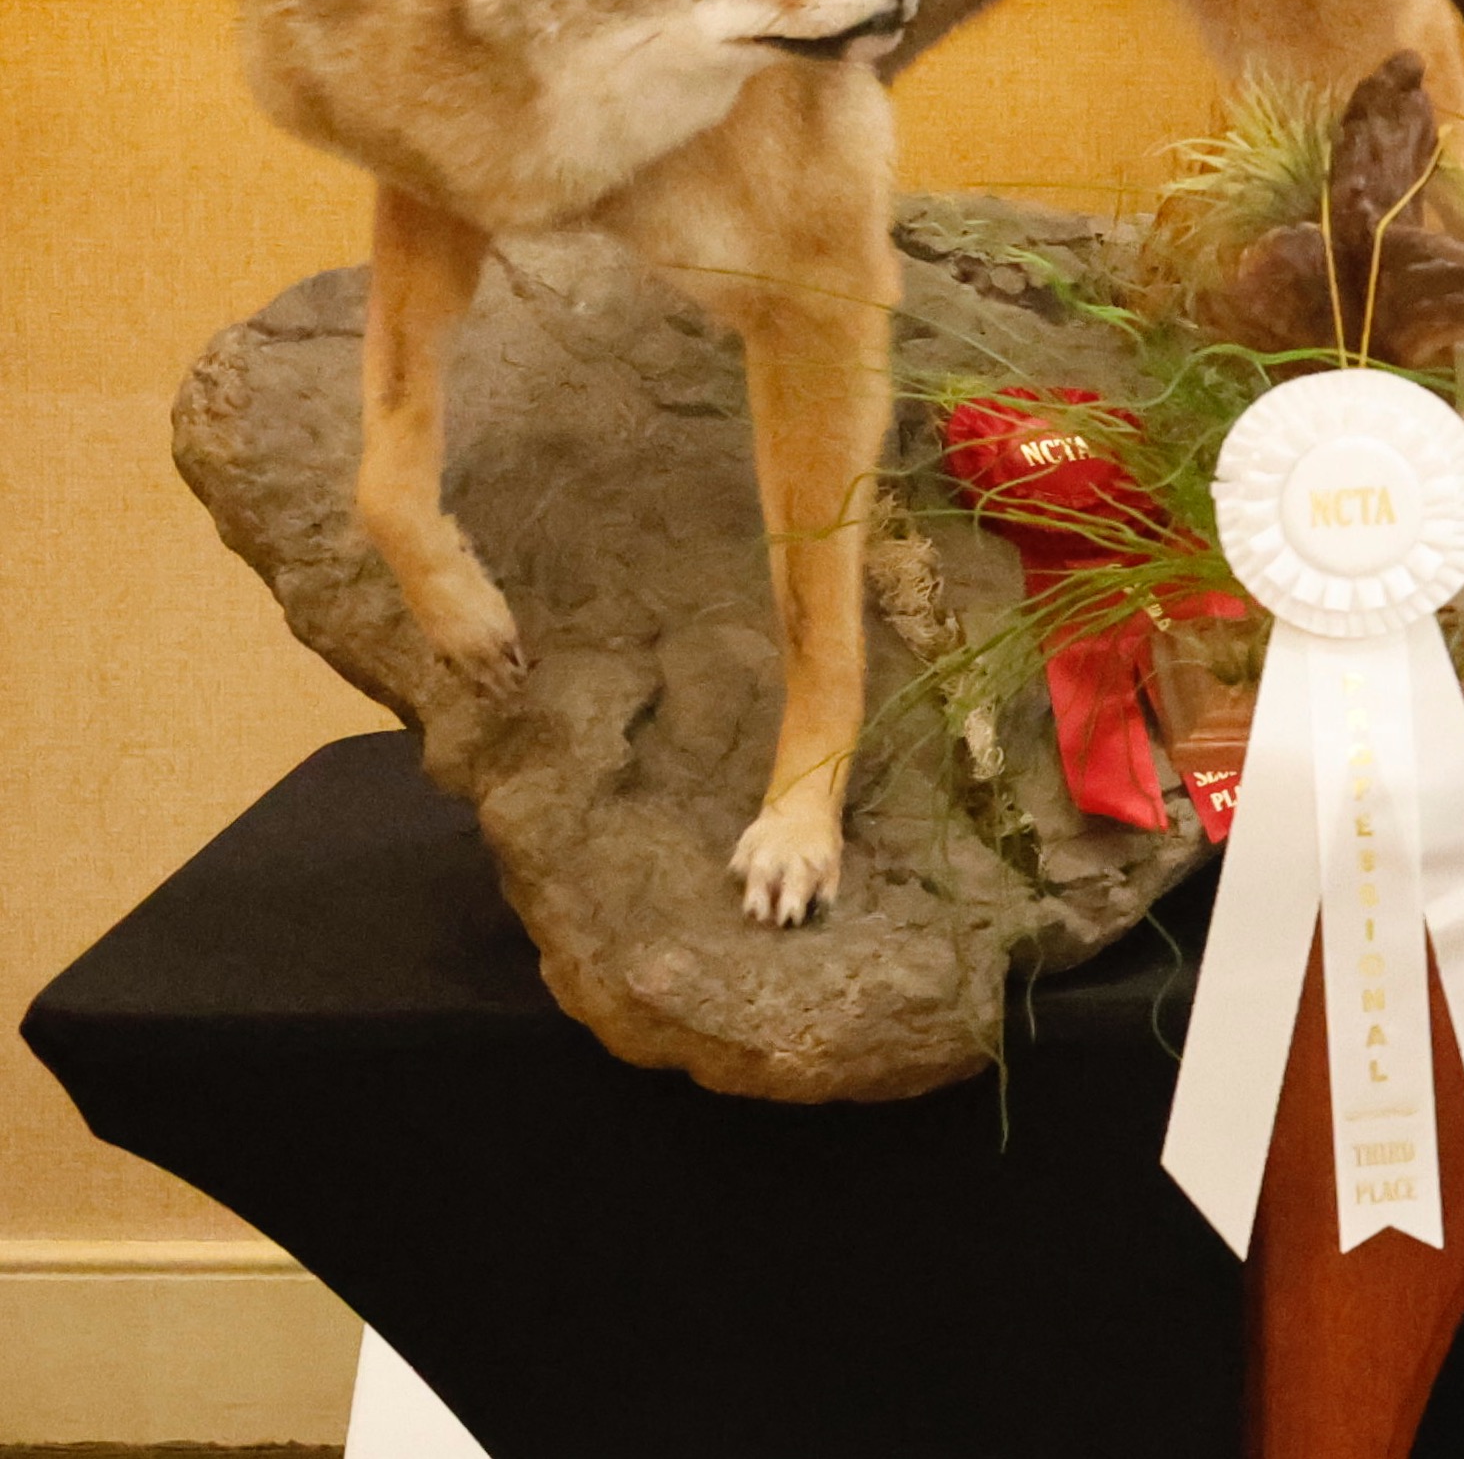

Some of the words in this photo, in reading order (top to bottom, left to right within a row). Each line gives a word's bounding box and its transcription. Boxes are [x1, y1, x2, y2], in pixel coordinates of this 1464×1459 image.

[1020, 435, 1090, 467] NCTA
[1309, 485, 1397, 527] NCTA
[1355, 1175, 1418, 1205] PLACE
